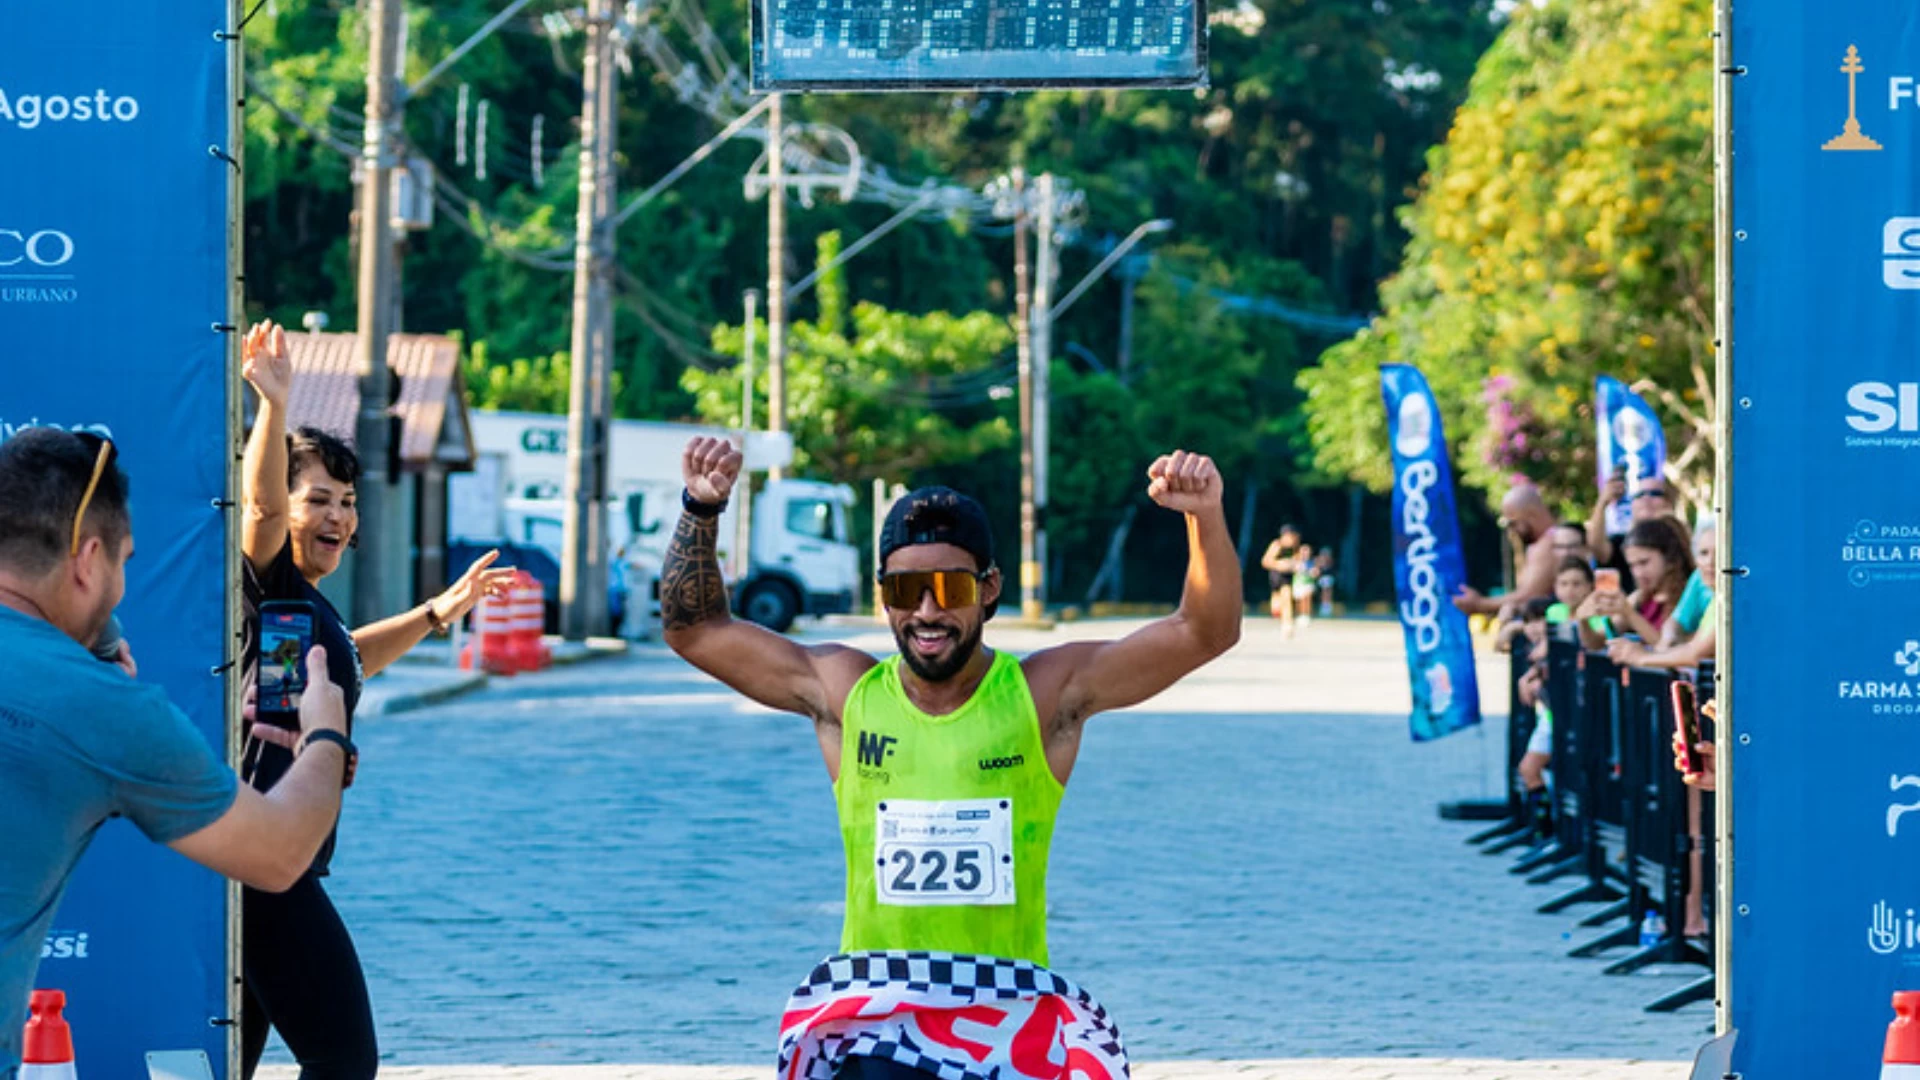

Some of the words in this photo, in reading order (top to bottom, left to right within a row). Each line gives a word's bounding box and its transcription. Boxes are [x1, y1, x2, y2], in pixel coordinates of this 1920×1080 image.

[1842, 545, 1904, 561] BELLA
[1839, 681, 1913, 698] FARMA
[890, 849, 982, 891] 225
